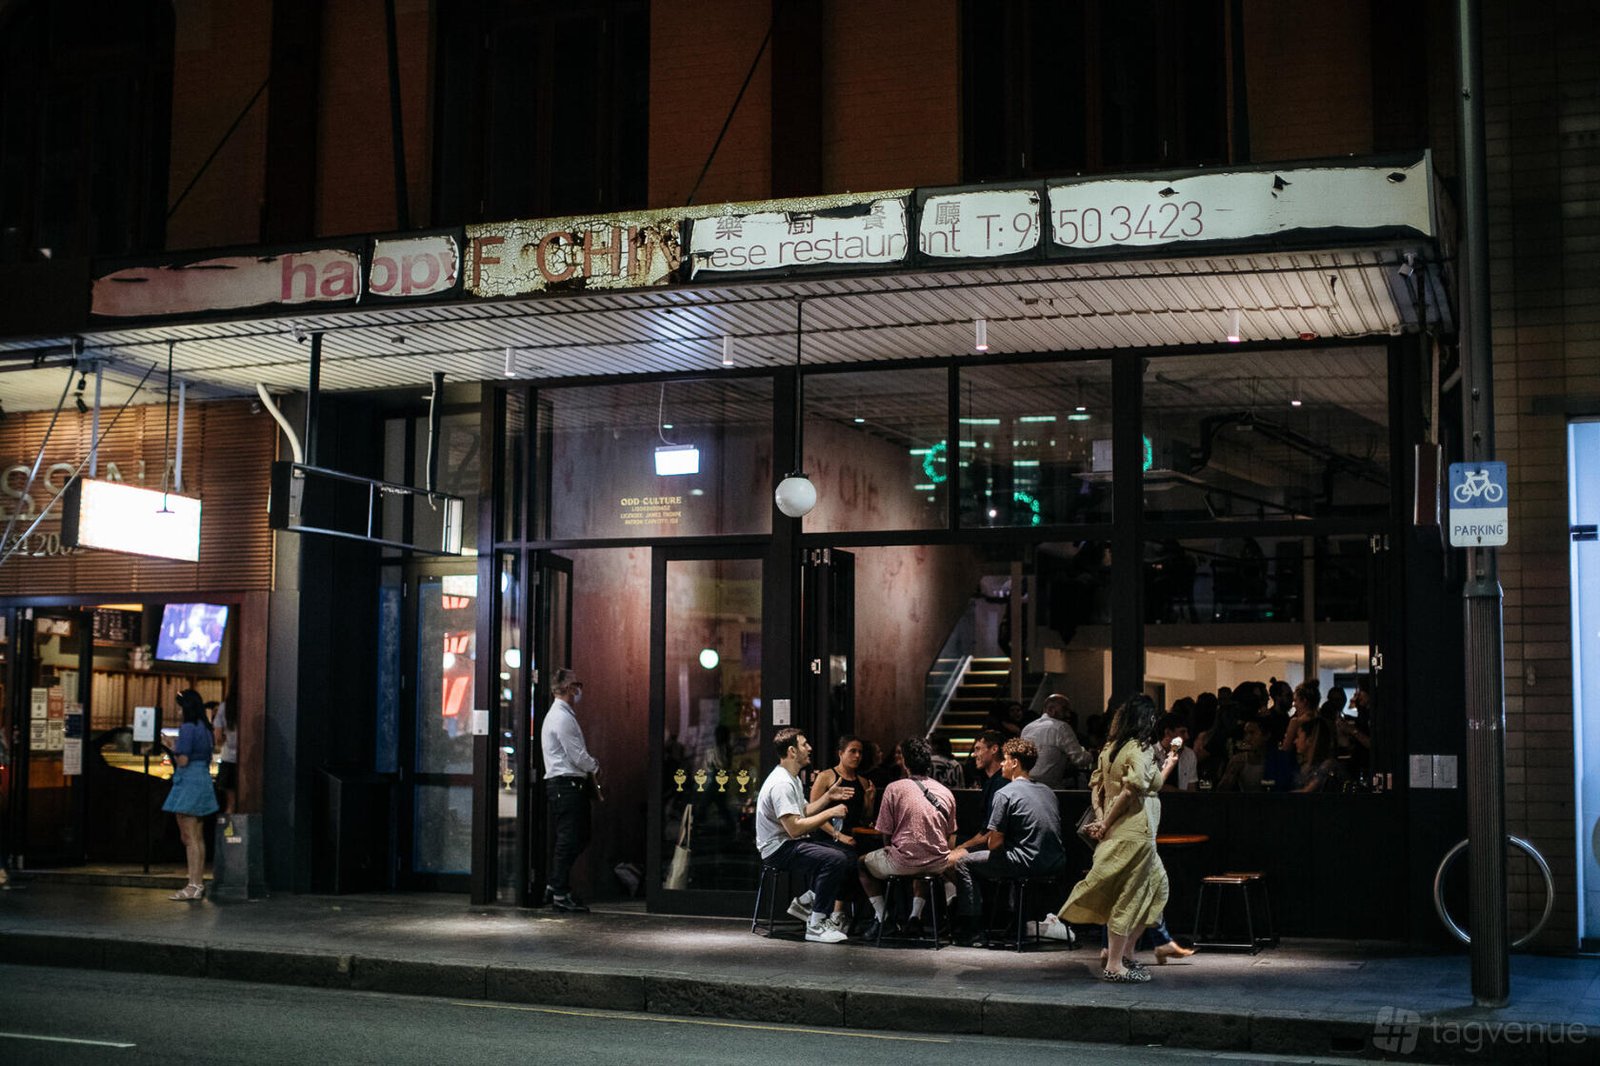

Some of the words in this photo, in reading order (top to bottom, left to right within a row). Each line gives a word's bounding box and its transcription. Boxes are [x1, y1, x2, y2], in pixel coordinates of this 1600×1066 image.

[621, 497, 640, 506] ODD
[643, 496, 682, 505] CULTURE
[1454, 524, 1504, 537] PARKING
